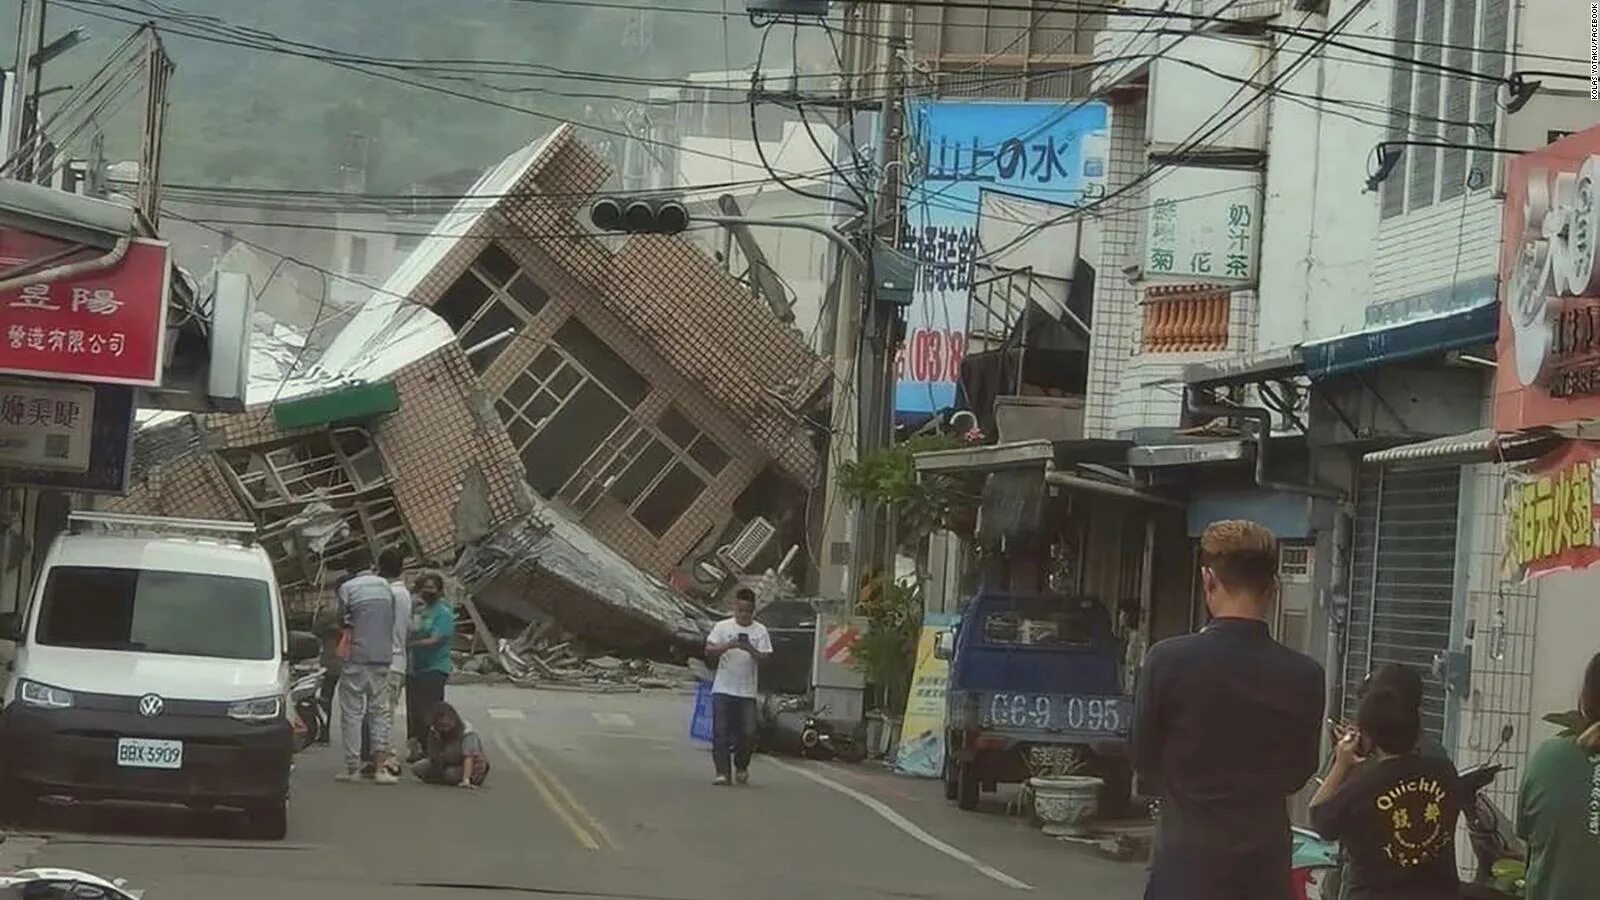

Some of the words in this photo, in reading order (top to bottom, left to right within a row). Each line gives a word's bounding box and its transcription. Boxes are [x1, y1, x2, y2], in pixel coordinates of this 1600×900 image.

[924, 135, 1069, 184] 山上の水
[9, 283, 125, 314] 昱陽
[8, 324, 126, 357] 營造有限公司
[1376, 776, 1447, 811] Quickly
